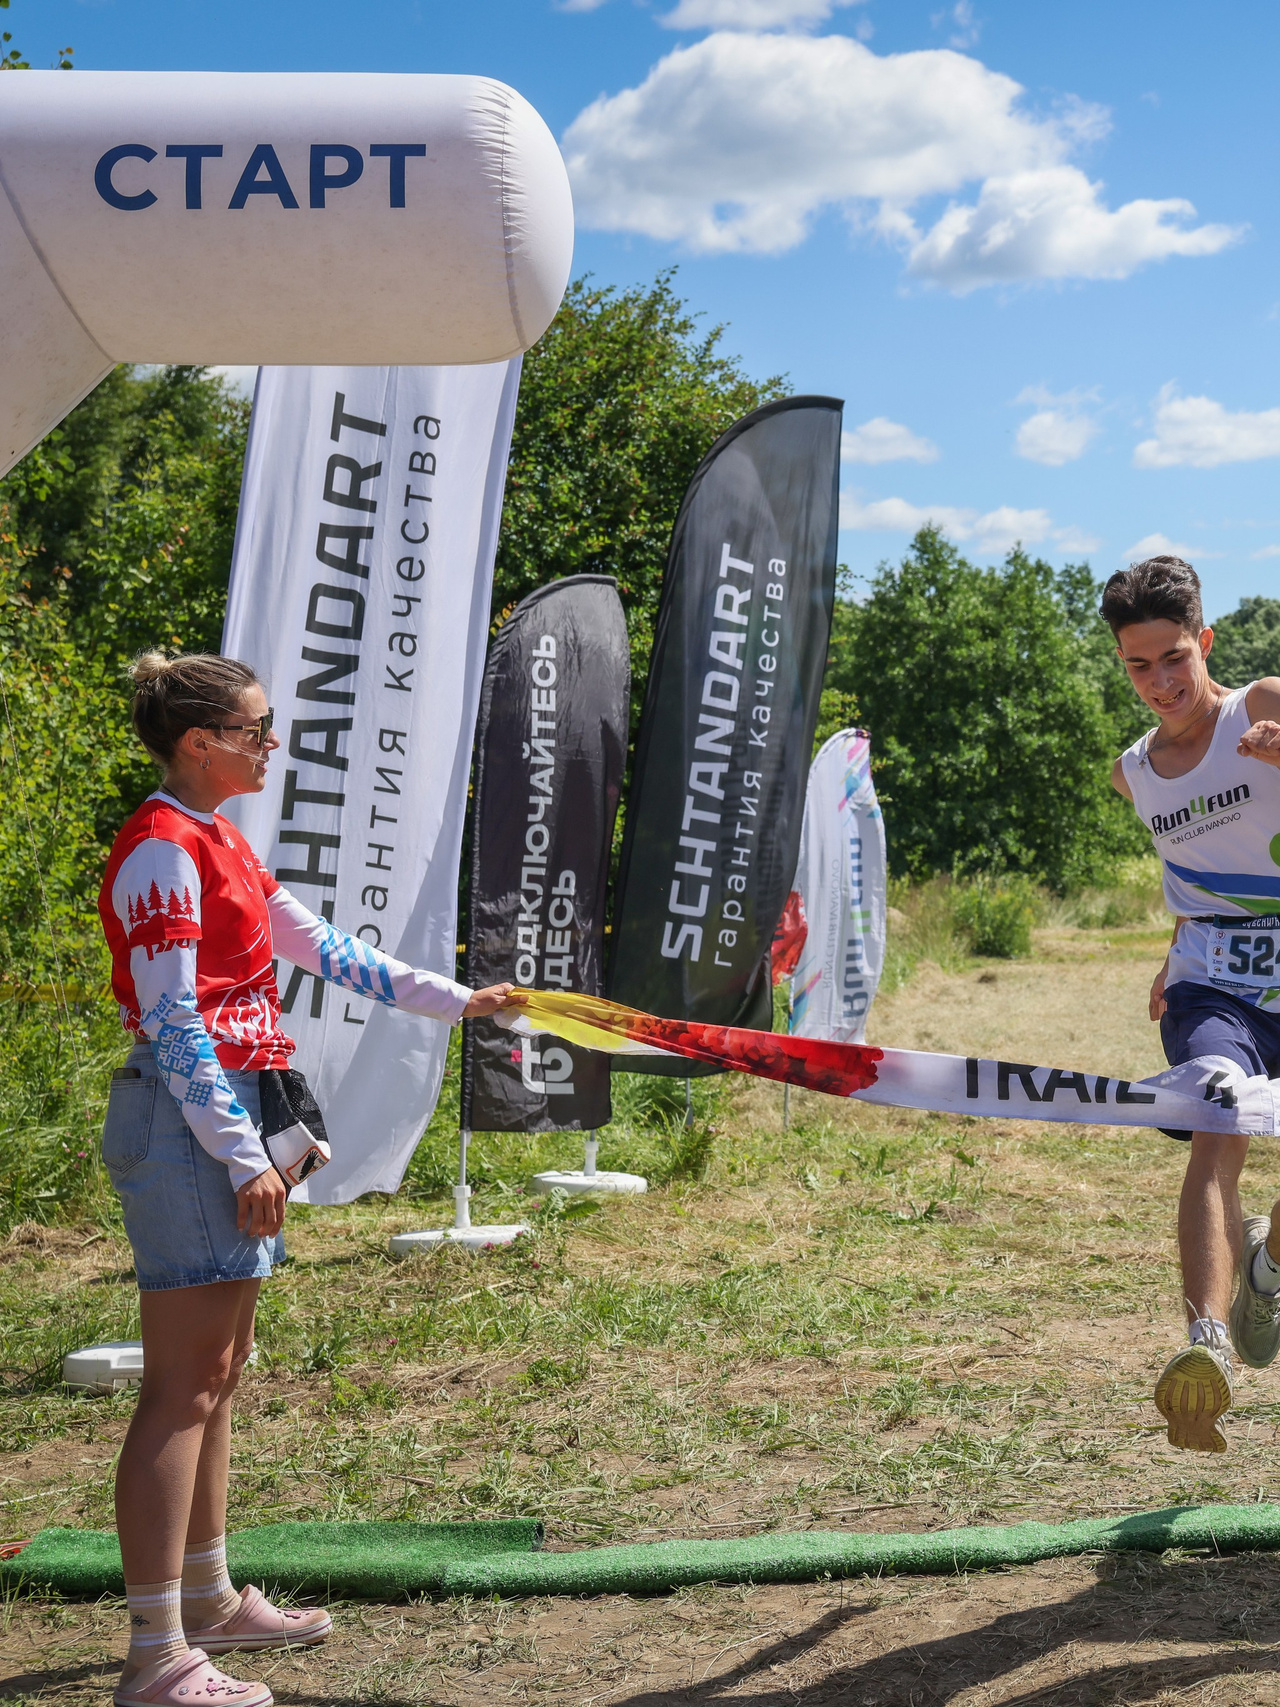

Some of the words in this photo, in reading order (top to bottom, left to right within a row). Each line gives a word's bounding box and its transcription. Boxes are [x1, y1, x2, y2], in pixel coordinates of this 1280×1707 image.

[94, 143, 427, 212] СТАРТ
[273, 392, 388, 1020] SHTANDART
[344, 727, 406, 1025] грантия
[384, 413, 441, 692] качества
[514, 634, 558, 988] ОДКЛЮЧАЙТЕСЬ
[660, 542, 756, 962] SCHTANDART
[714, 769, 763, 968] гарантия
[747, 556, 787, 748] качества
[1170, 834, 1184, 845] RUN
[1184, 826, 1205, 841] CLUB
[1205, 812, 1242, 832] IVANOVO
